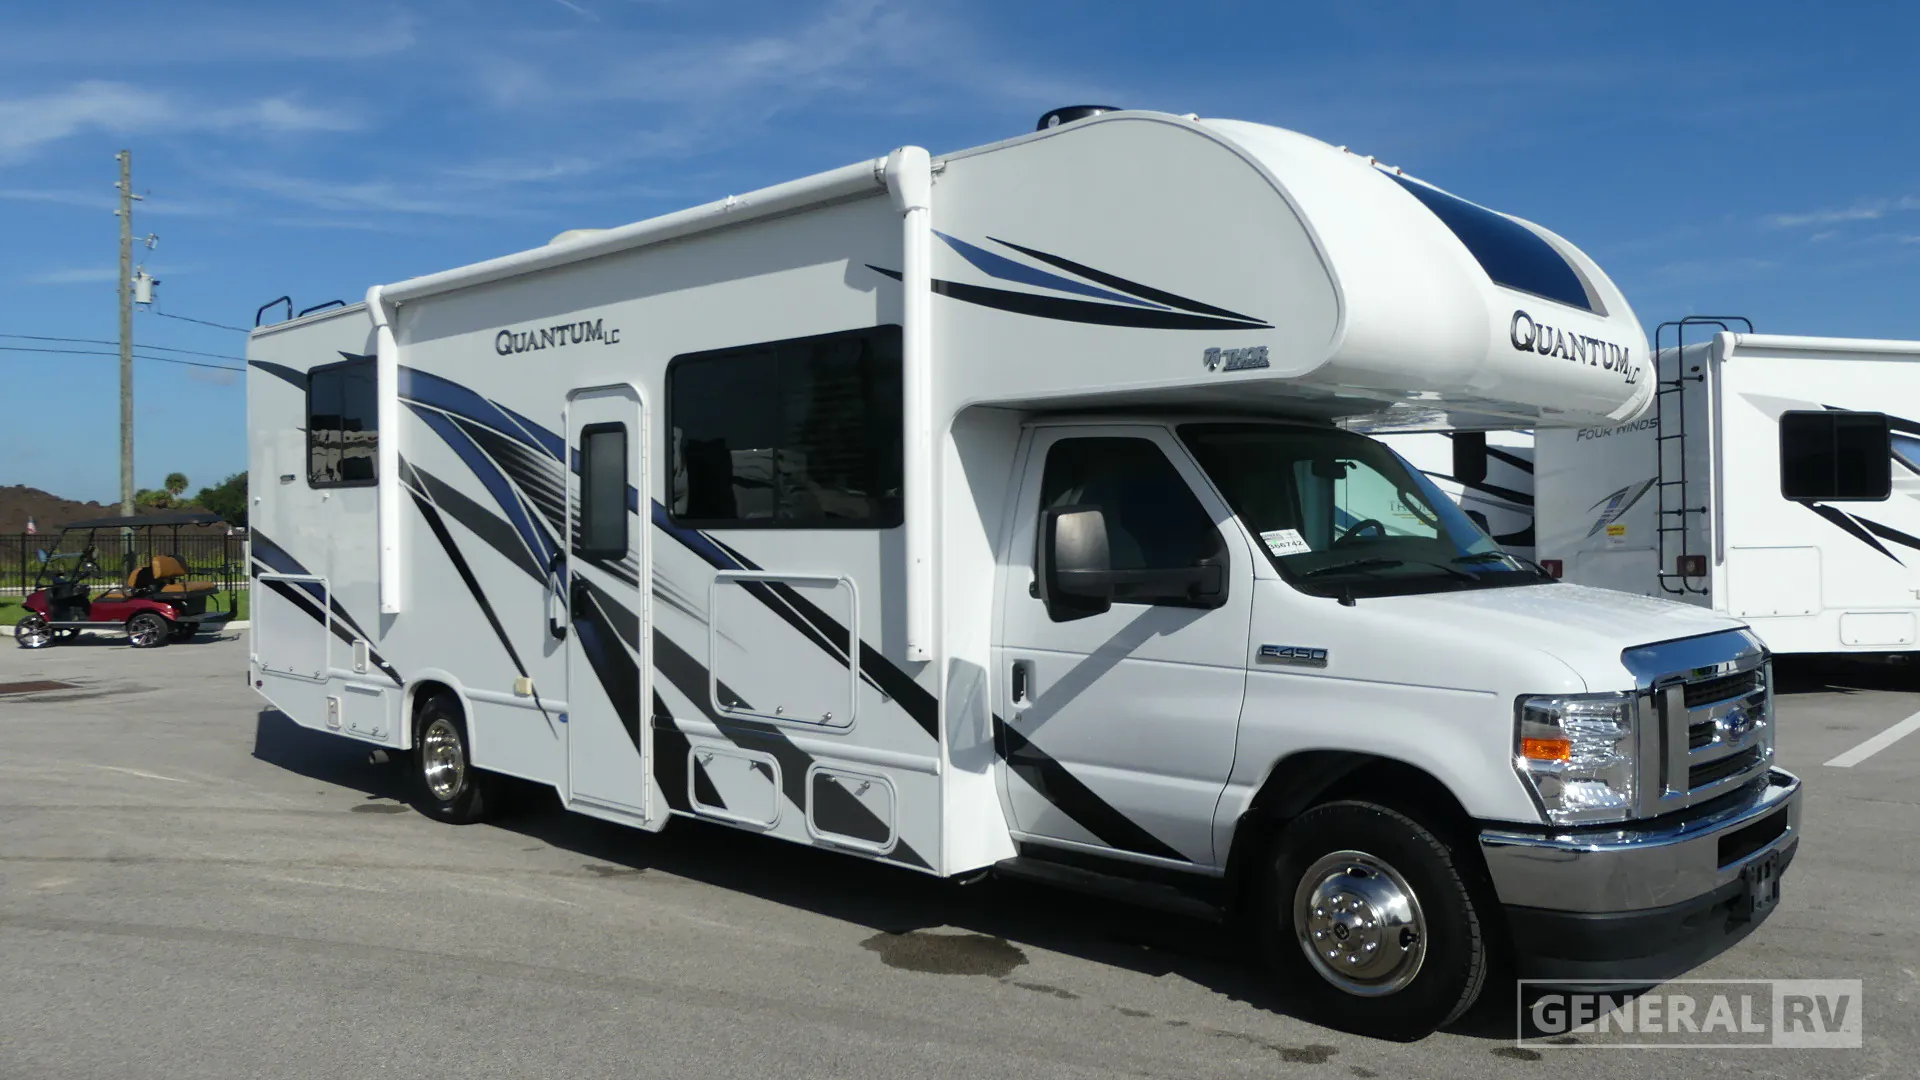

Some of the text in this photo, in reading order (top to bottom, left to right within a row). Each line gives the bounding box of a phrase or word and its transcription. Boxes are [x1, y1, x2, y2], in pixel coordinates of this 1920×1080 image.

[495, 318, 620, 356] QUANTUM LC
[1510, 309, 1641, 385] QUANTUM LC
